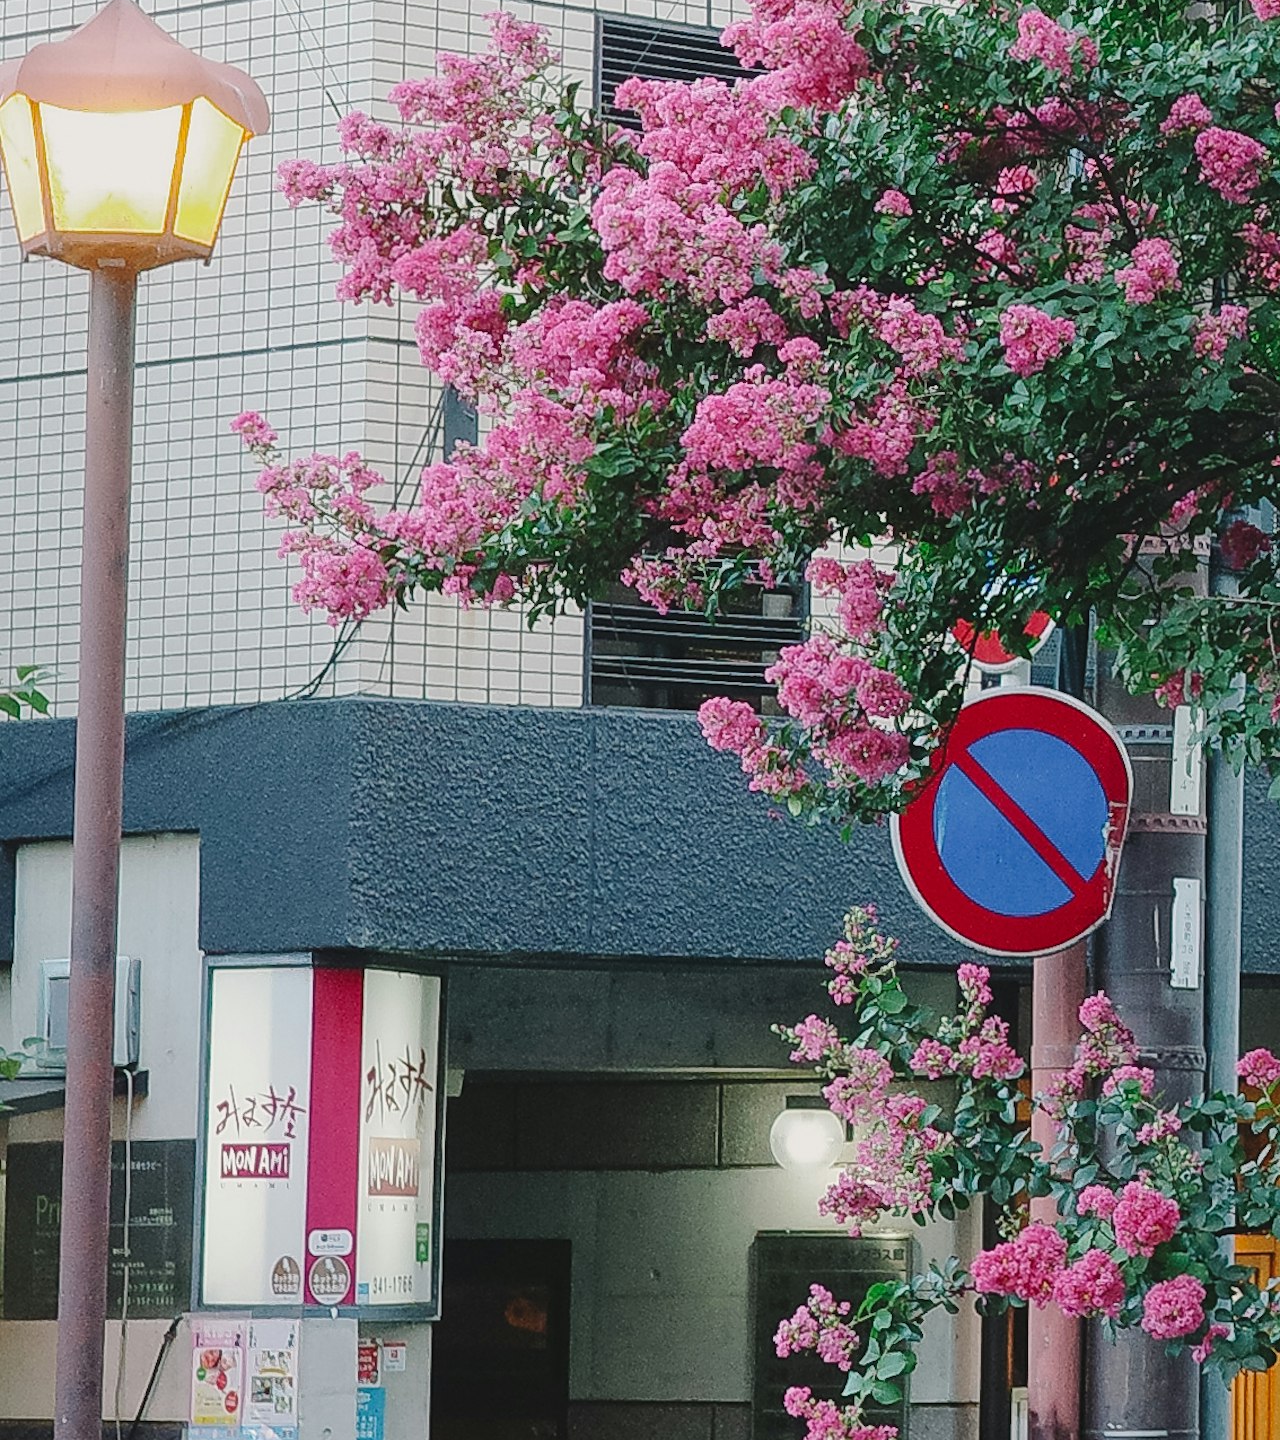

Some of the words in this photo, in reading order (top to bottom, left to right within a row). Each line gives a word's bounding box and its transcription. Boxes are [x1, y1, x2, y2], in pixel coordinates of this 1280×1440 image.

[216, 1083, 307, 1139] みます屋
[222, 1146, 255, 1177] MON
[370, 1145, 395, 1191] MON
